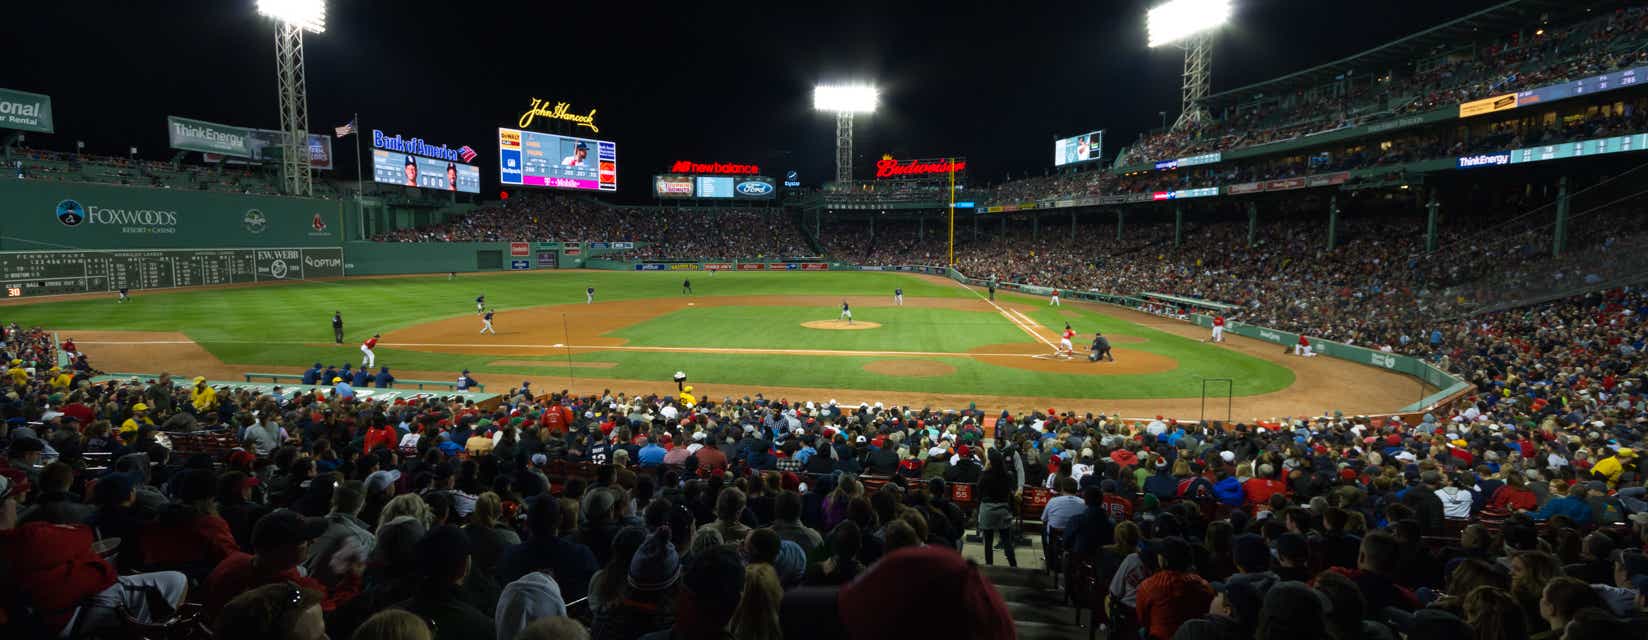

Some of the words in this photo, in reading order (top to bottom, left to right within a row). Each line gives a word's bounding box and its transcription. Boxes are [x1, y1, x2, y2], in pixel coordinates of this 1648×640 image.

[9, 115, 38, 126] Rental
[519, 97, 553, 128] John
[552, 101, 599, 133] Hancock
[173, 122, 245, 147] ThinkEnergy
[373, 129, 405, 152] Bank
[405, 137, 417, 154] of
[418, 138, 458, 161] America
[1460, 154, 1508, 167] ThinkEnergy
[691, 163, 714, 173] new
[714, 162, 759, 174] balance
[876, 158, 967, 178] Budweiser
[743, 183, 766, 193] Ford
[88, 206, 177, 226] FOXWOODS
[274, 250, 298, 260] WEBB
[314, 258, 341, 268] OPTUM
[8, 288, 20, 297] 30
